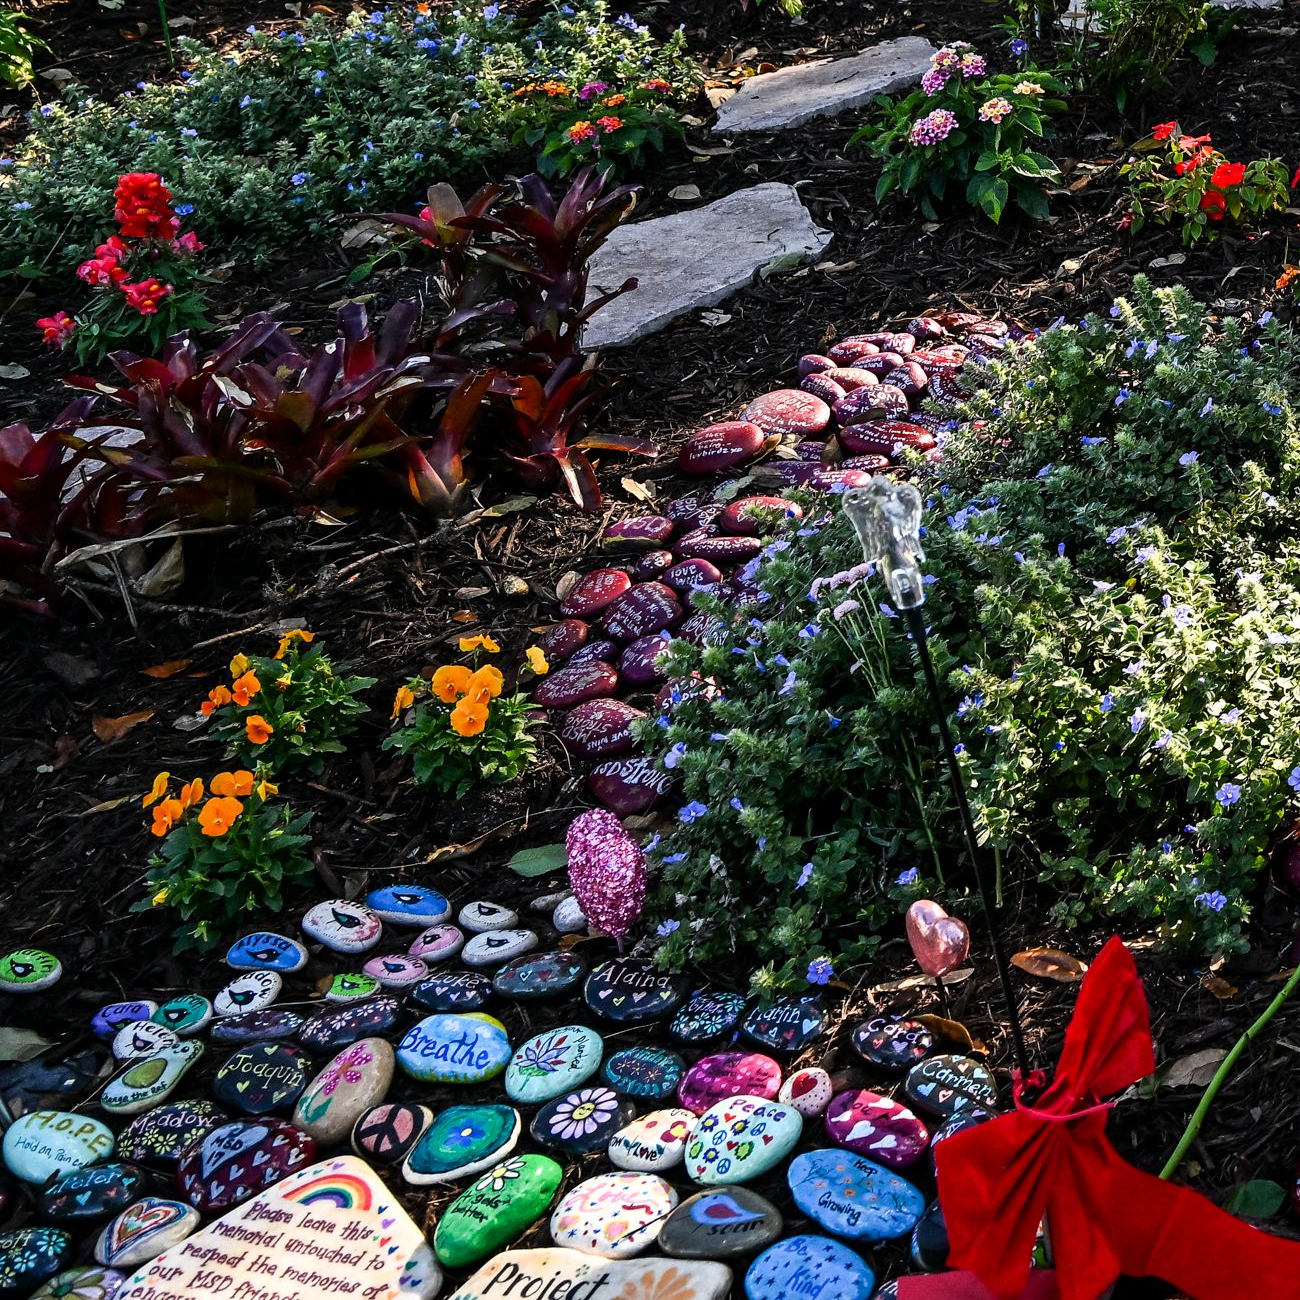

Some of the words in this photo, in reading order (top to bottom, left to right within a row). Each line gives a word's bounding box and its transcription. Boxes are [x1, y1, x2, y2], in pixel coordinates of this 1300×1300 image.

[430, 973, 479, 989] Luke
[594, 965, 671, 988] Alaina
[102, 1004, 142, 1018] Cara
[868, 1019, 920, 1044] Cara
[399, 1026, 491, 1070] Breathe
[227, 1053, 303, 1089] Joaquin
[922, 1060, 992, 1099] Carmen
[131, 1086, 150, 1099] the
[728, 1099, 787, 1122] Peace
[129, 1113, 218, 1135] Meadow
[14, 1136, 38, 1152] Hold
[212, 1135, 243, 1151] MSD
[208, 1149, 222, 1164] 17
[853, 1159, 878, 1177] Keep
[450, 1203, 490, 1224] better
[471, 1193, 503, 1211] gets
[818, 1191, 862, 1226] Growing
[297, 1213, 334, 1234] leave
[340, 1220, 374, 1241] this
[706, 1218, 765, 1236] soar
[211, 1220, 281, 1248] memorial
[285, 1236, 365, 1270] untouched
[365, 1252, 386, 1271] to
[786, 1238, 810, 1257] Be
[148, 1264, 185, 1283] our
[193, 1270, 234, 1295] MSD
[249, 1252, 277, 1276] the
[283, 1260, 361, 1295] memories
[481, 1261, 613, 1300] Project
[786, 1268, 831, 1299] Kind
